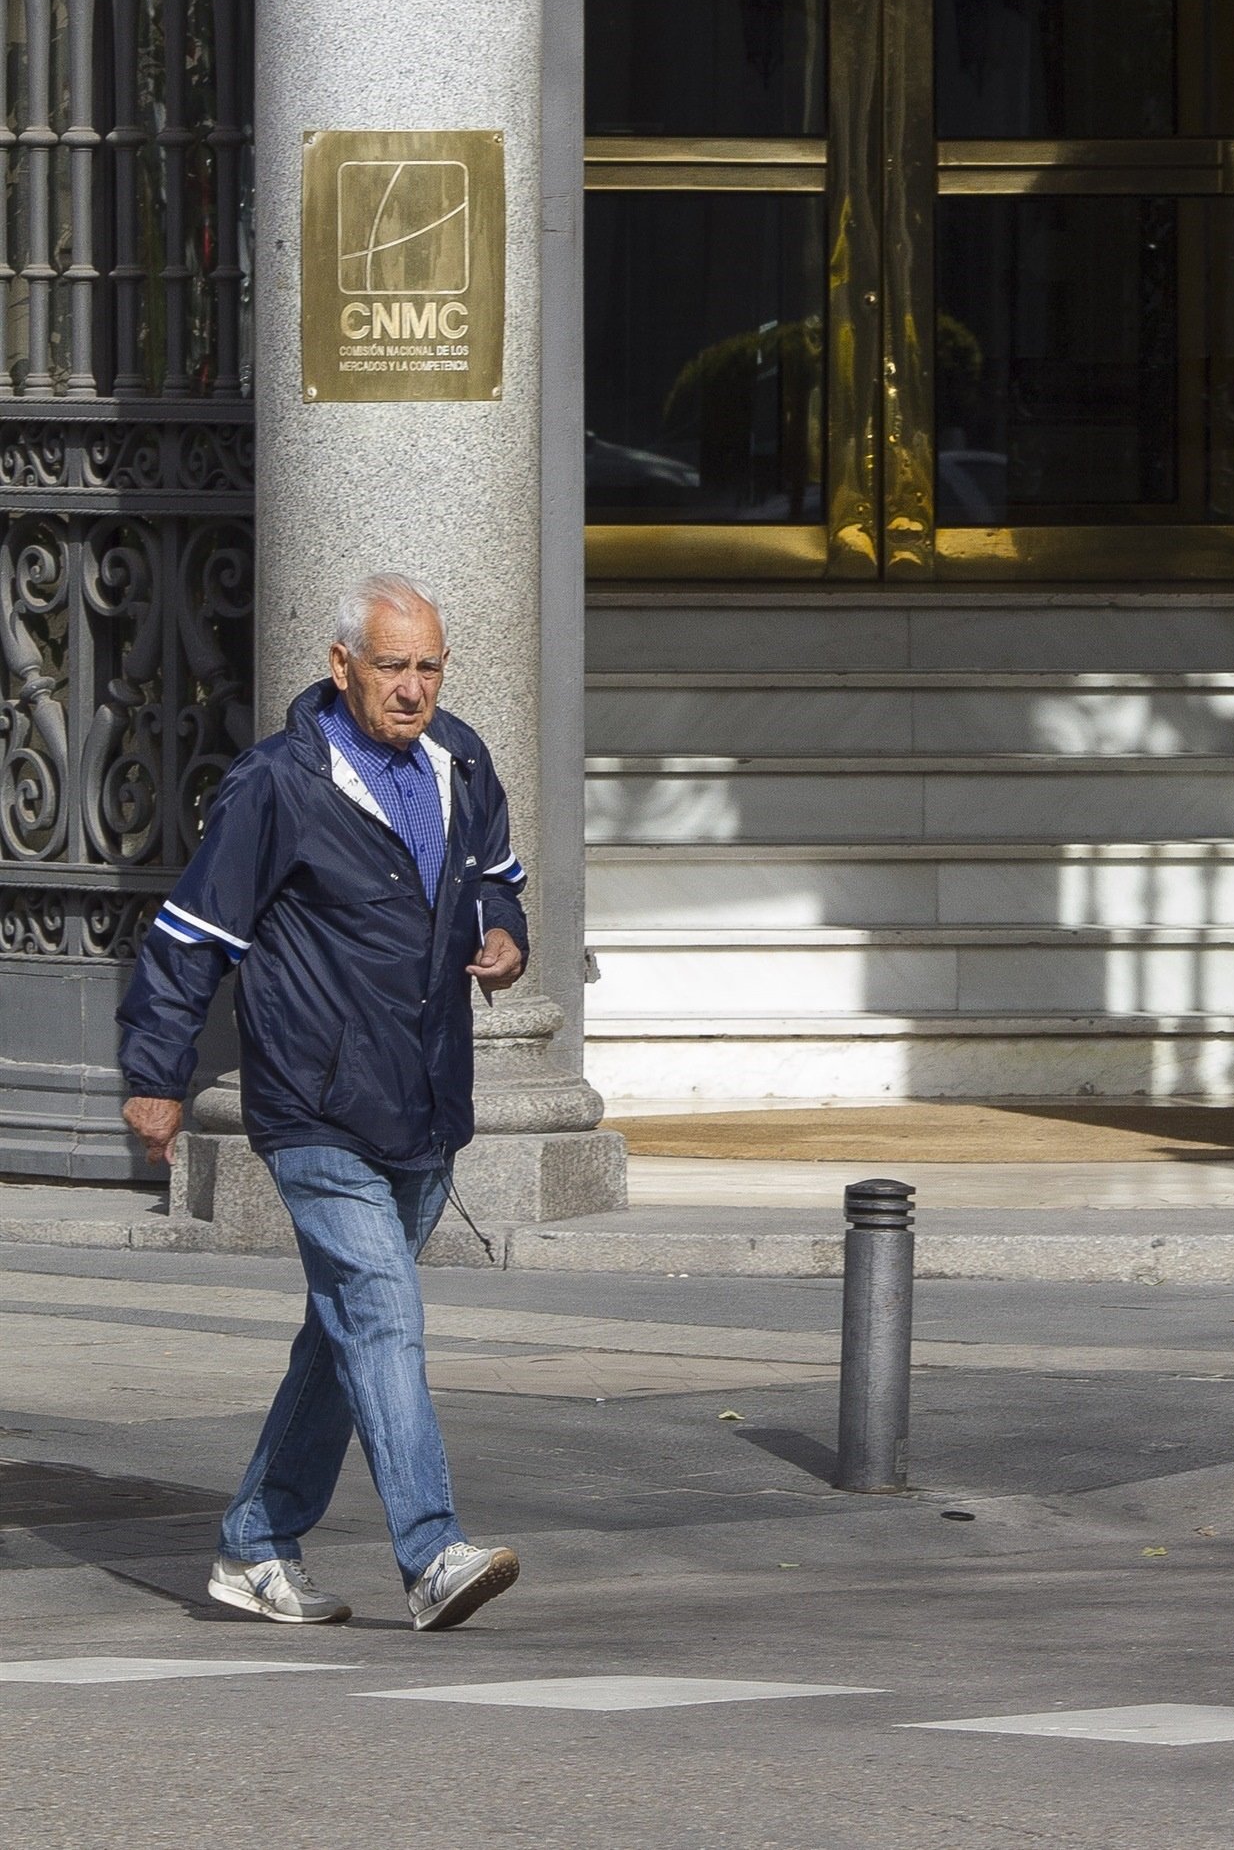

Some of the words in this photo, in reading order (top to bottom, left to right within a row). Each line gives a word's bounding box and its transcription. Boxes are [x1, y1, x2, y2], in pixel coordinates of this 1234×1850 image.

[340, 301, 469, 339] CNMC
[339, 343, 385, 357] COMISIÓN
[386, 345, 435, 357] NACIONAL
[436, 345, 449, 356] DE
[451, 345, 469, 356] LOS
[339, 360, 387, 372] MERCADOS
[387, 360, 395, 371] Y
[396, 360, 408, 371] LA
[410, 360, 469, 372] COMPETENCIA
